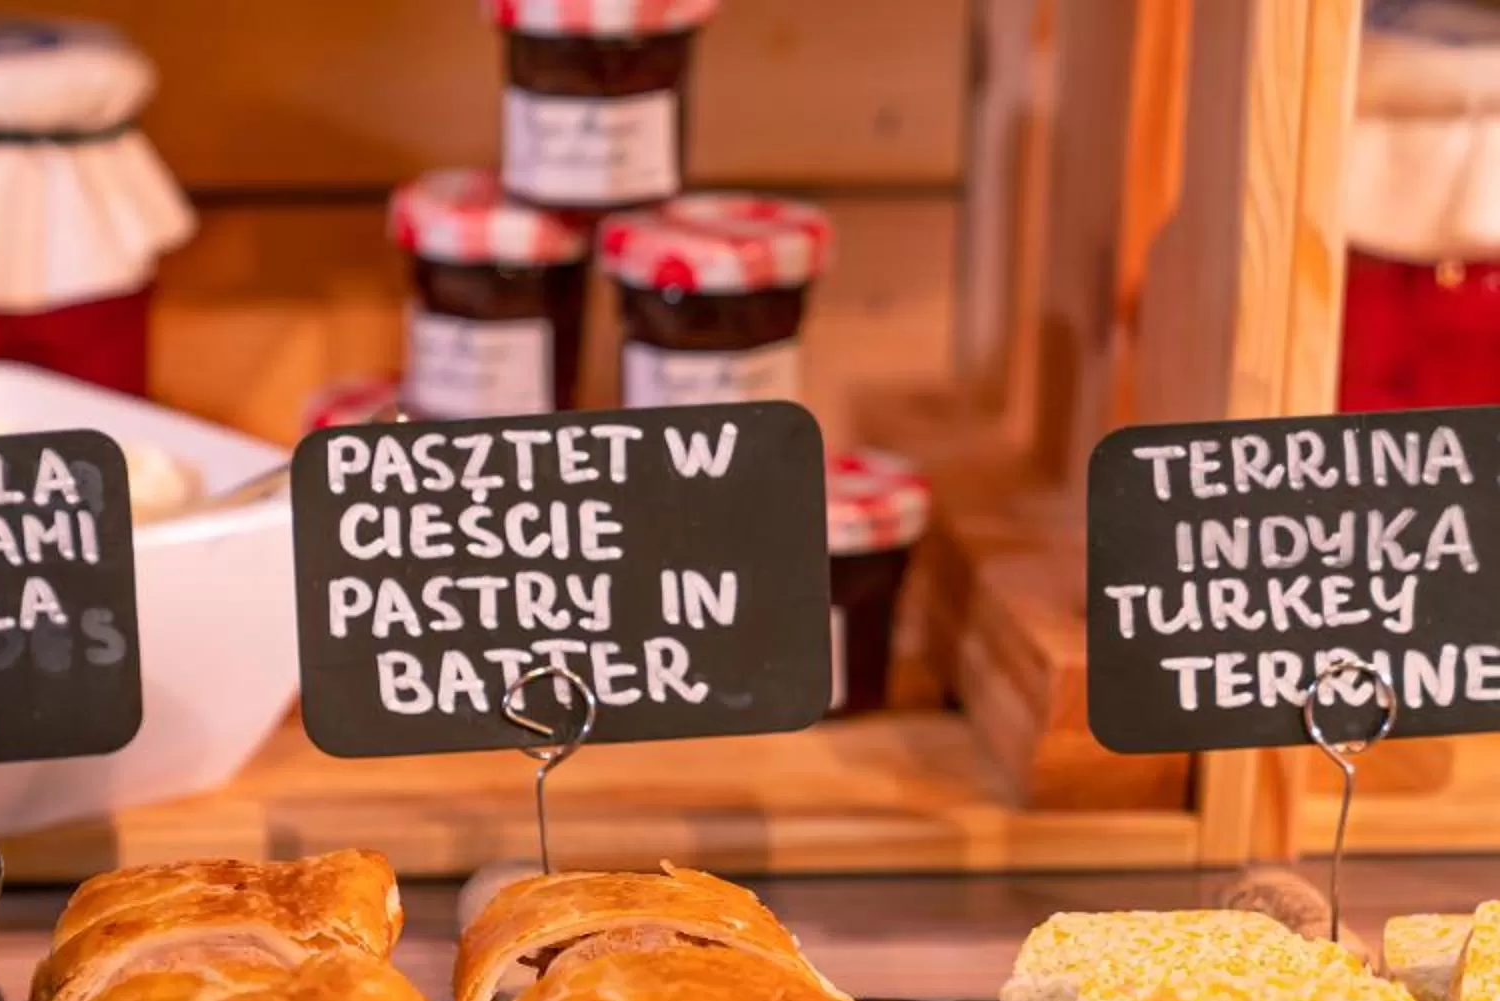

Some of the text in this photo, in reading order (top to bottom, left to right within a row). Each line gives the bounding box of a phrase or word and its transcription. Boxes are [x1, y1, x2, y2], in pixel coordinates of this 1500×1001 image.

[664, 422, 739, 478] W
[1132, 426, 1474, 501] TERRINA
[1175, 504, 1480, 573] INDYKA
[327, 569, 738, 638] PASTRY IN
[1104, 574, 1419, 640] TURKEY
[376, 636, 710, 715] BATTER
[1159, 643, 1500, 712] TERRINE
